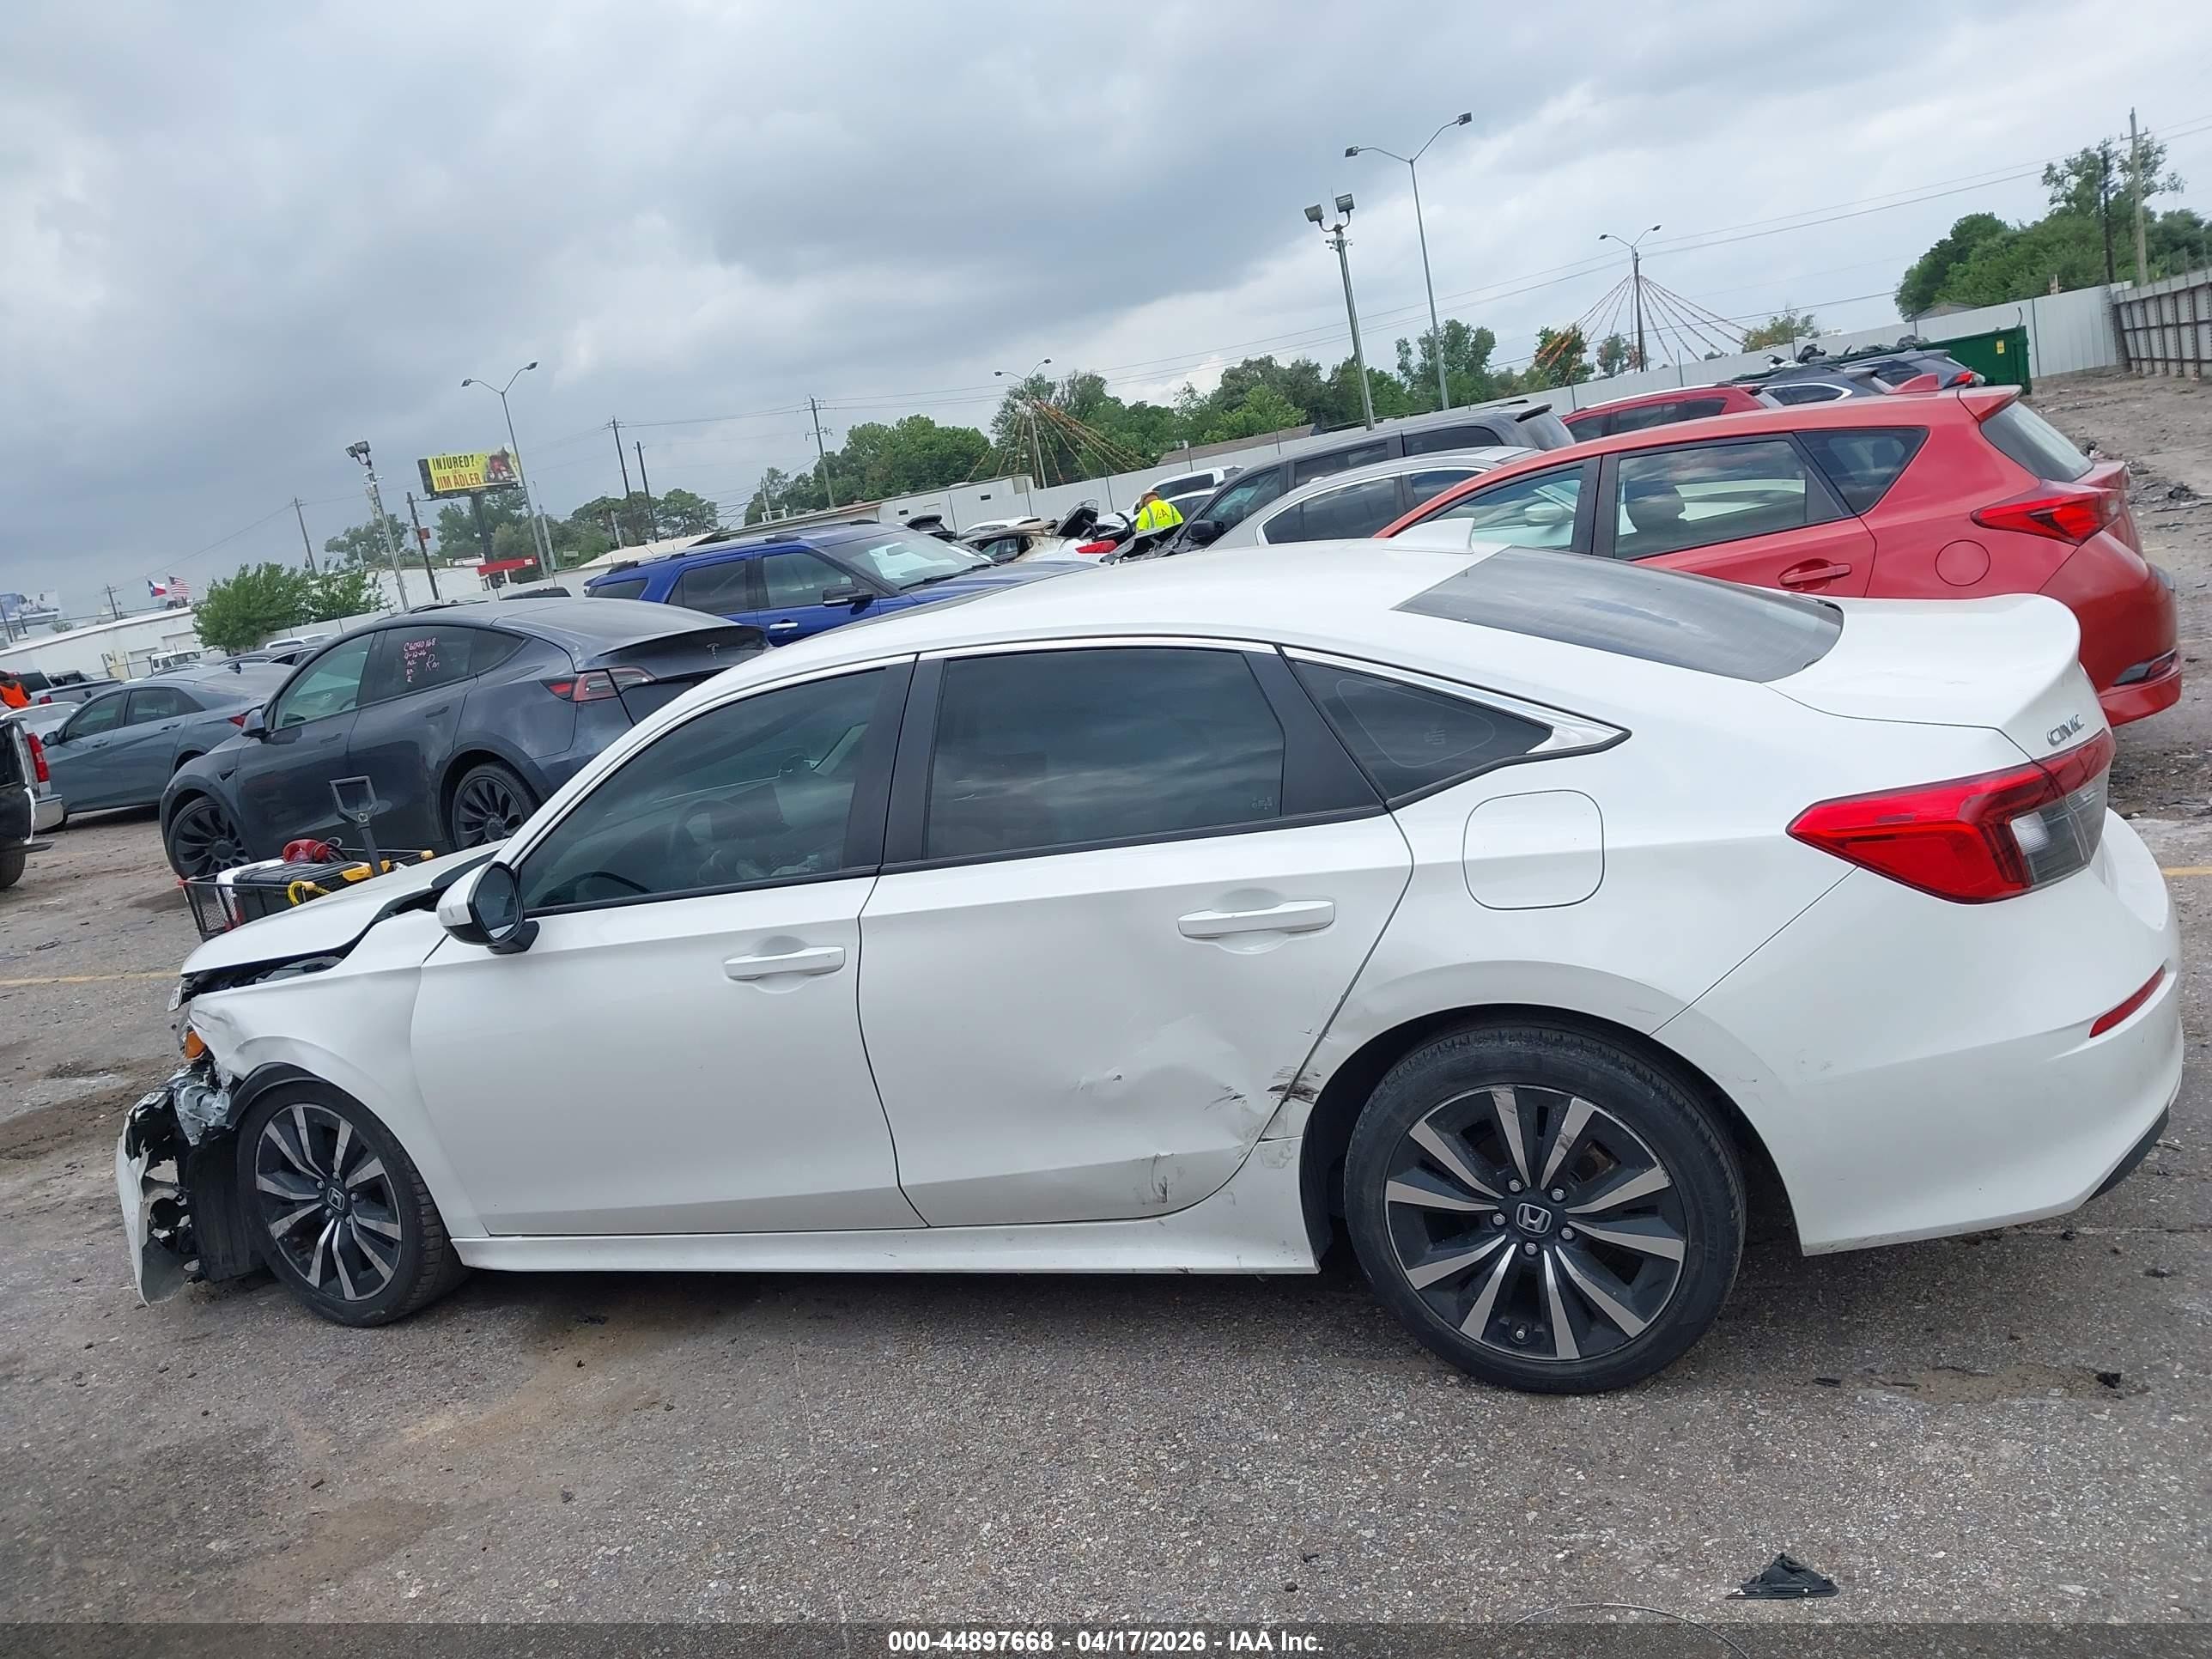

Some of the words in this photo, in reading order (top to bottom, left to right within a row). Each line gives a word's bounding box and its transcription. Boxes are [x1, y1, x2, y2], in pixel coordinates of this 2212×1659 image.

[432, 454, 475, 471] INJURED?
[436, 475, 452, 490] JIM
[453, 472, 482, 488] ADLER
